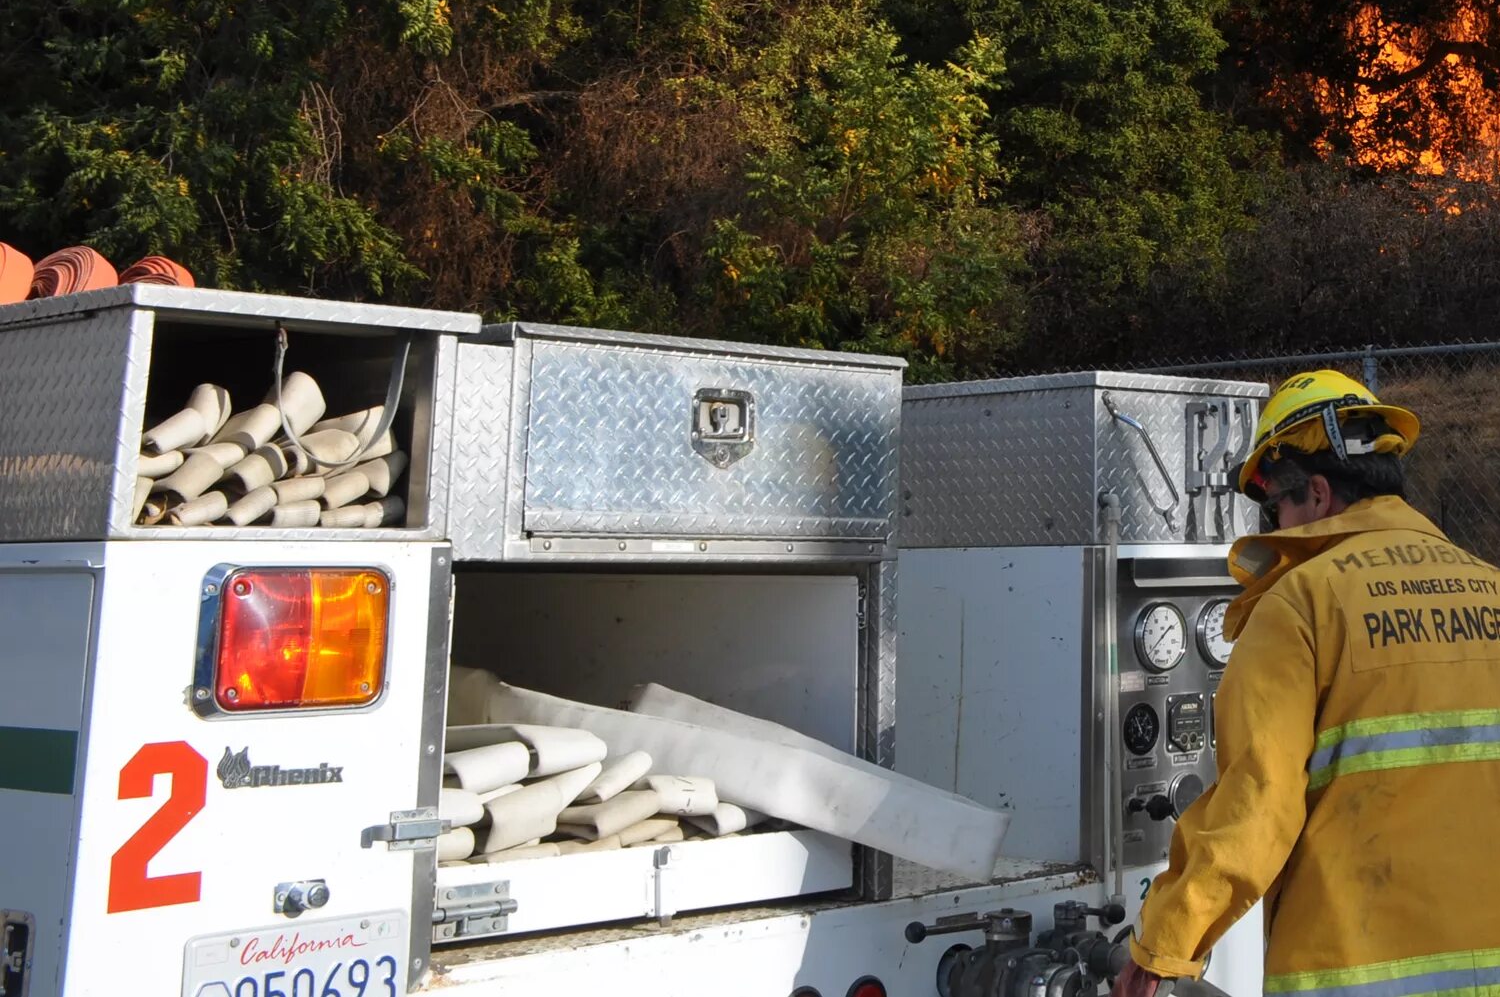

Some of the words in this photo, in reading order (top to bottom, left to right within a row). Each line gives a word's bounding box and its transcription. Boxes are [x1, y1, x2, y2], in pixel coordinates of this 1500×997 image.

[1367, 580, 1398, 597] LOS
[1401, 578, 1466, 595] ANGELES
[1468, 579, 1498, 596] CITY
[1363, 608, 1431, 648] PARK
[250, 762, 344, 788] Phenix
[107, 740, 208, 914] 2
[240, 933, 367, 965] California
